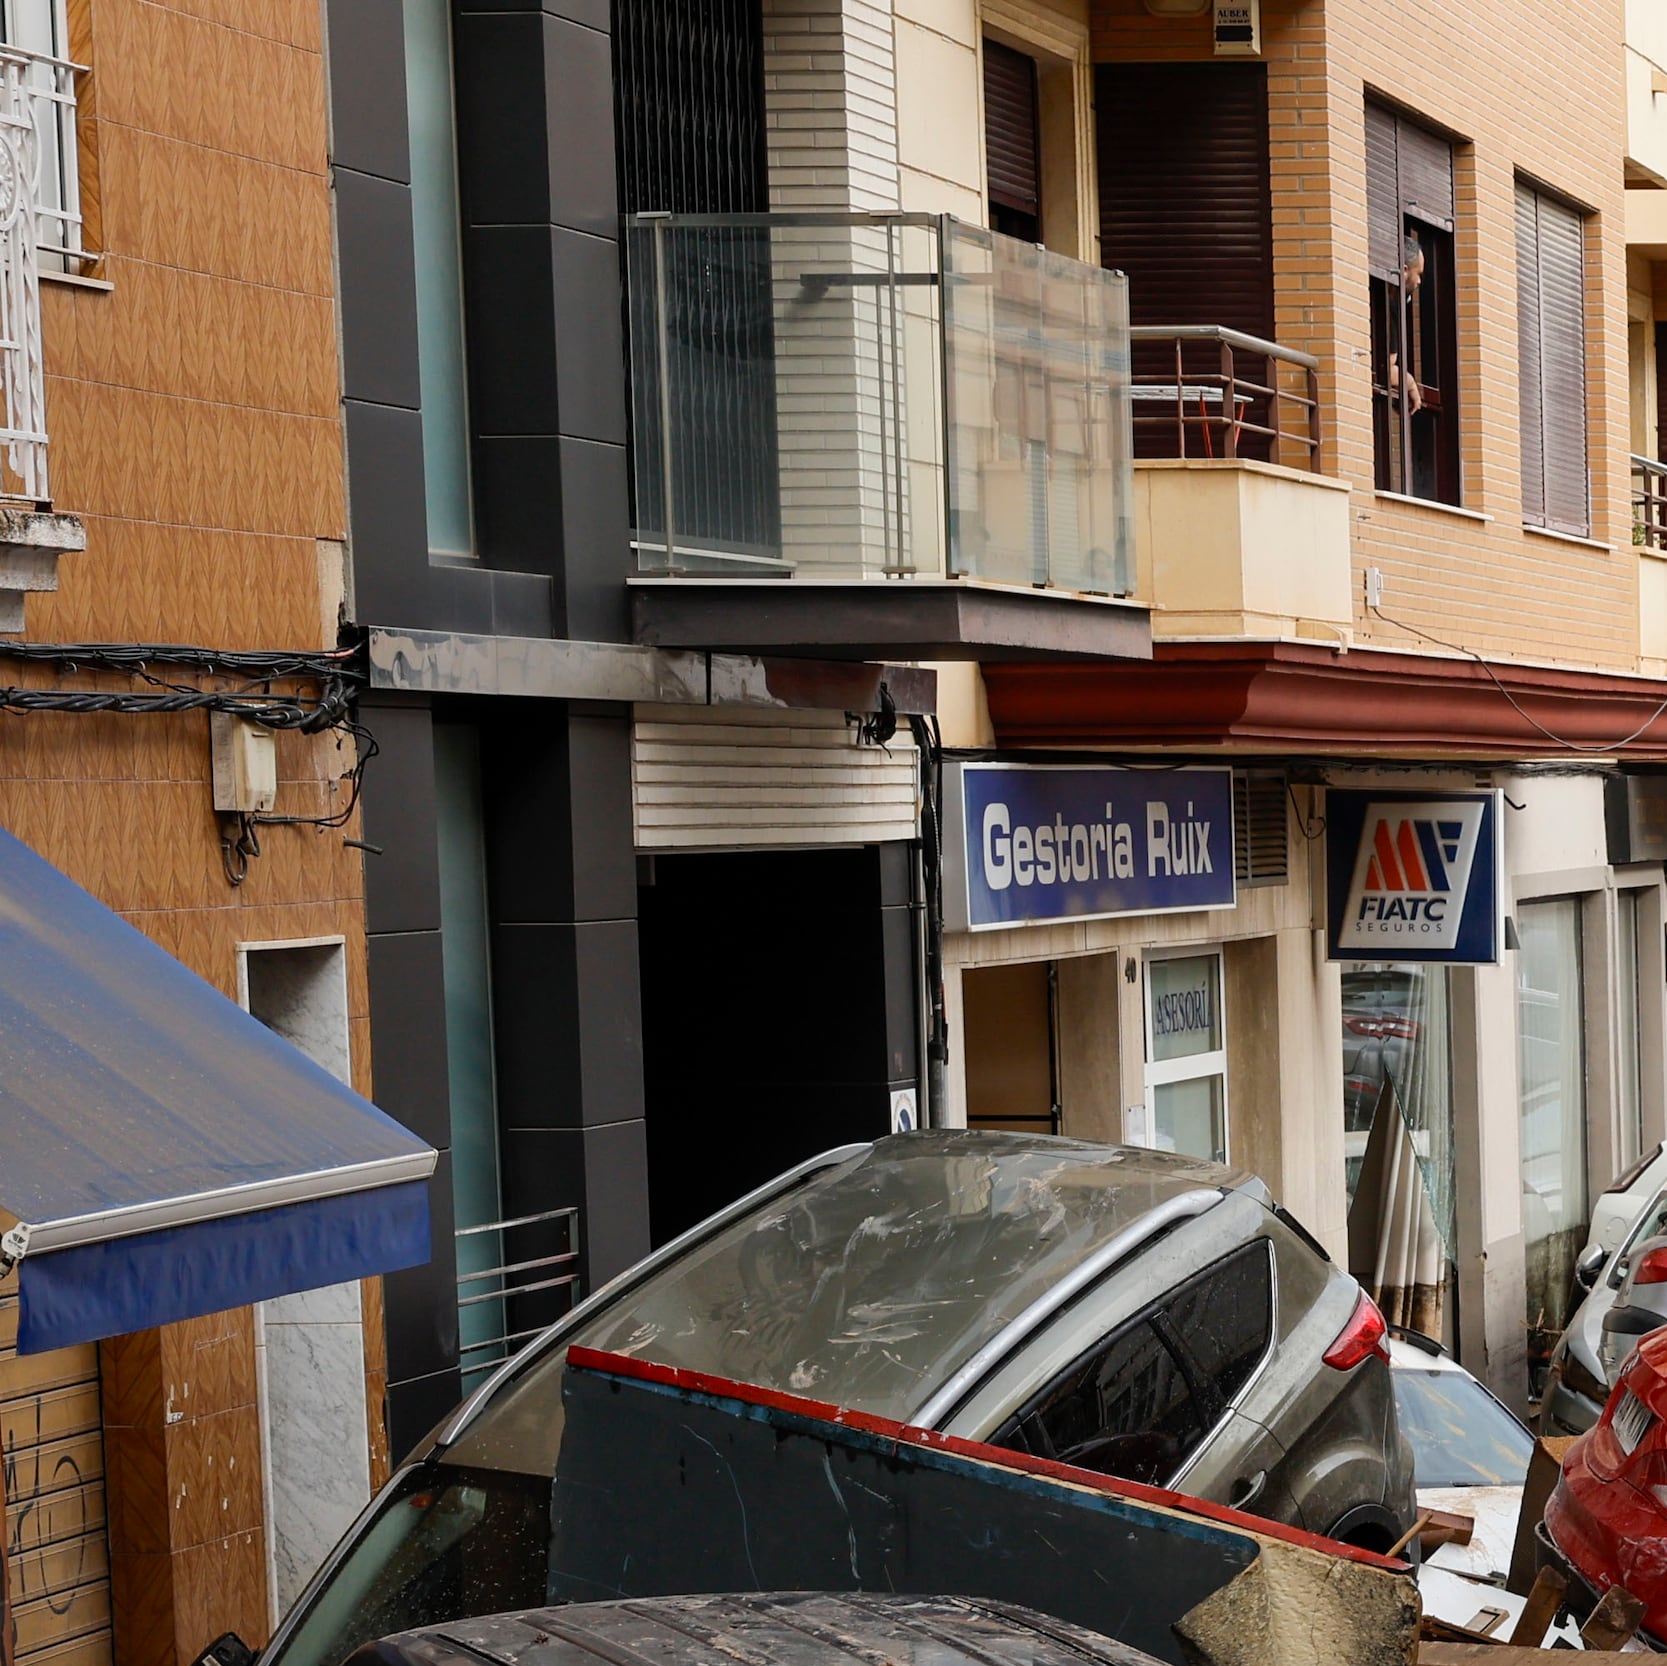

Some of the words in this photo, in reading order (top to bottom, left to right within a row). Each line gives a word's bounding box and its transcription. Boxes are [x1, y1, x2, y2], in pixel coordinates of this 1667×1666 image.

[1146, 800, 1214, 878] Ruix
[1358, 895, 1448, 922] FIATC
[1355, 921, 1443, 933] SEGUROS
